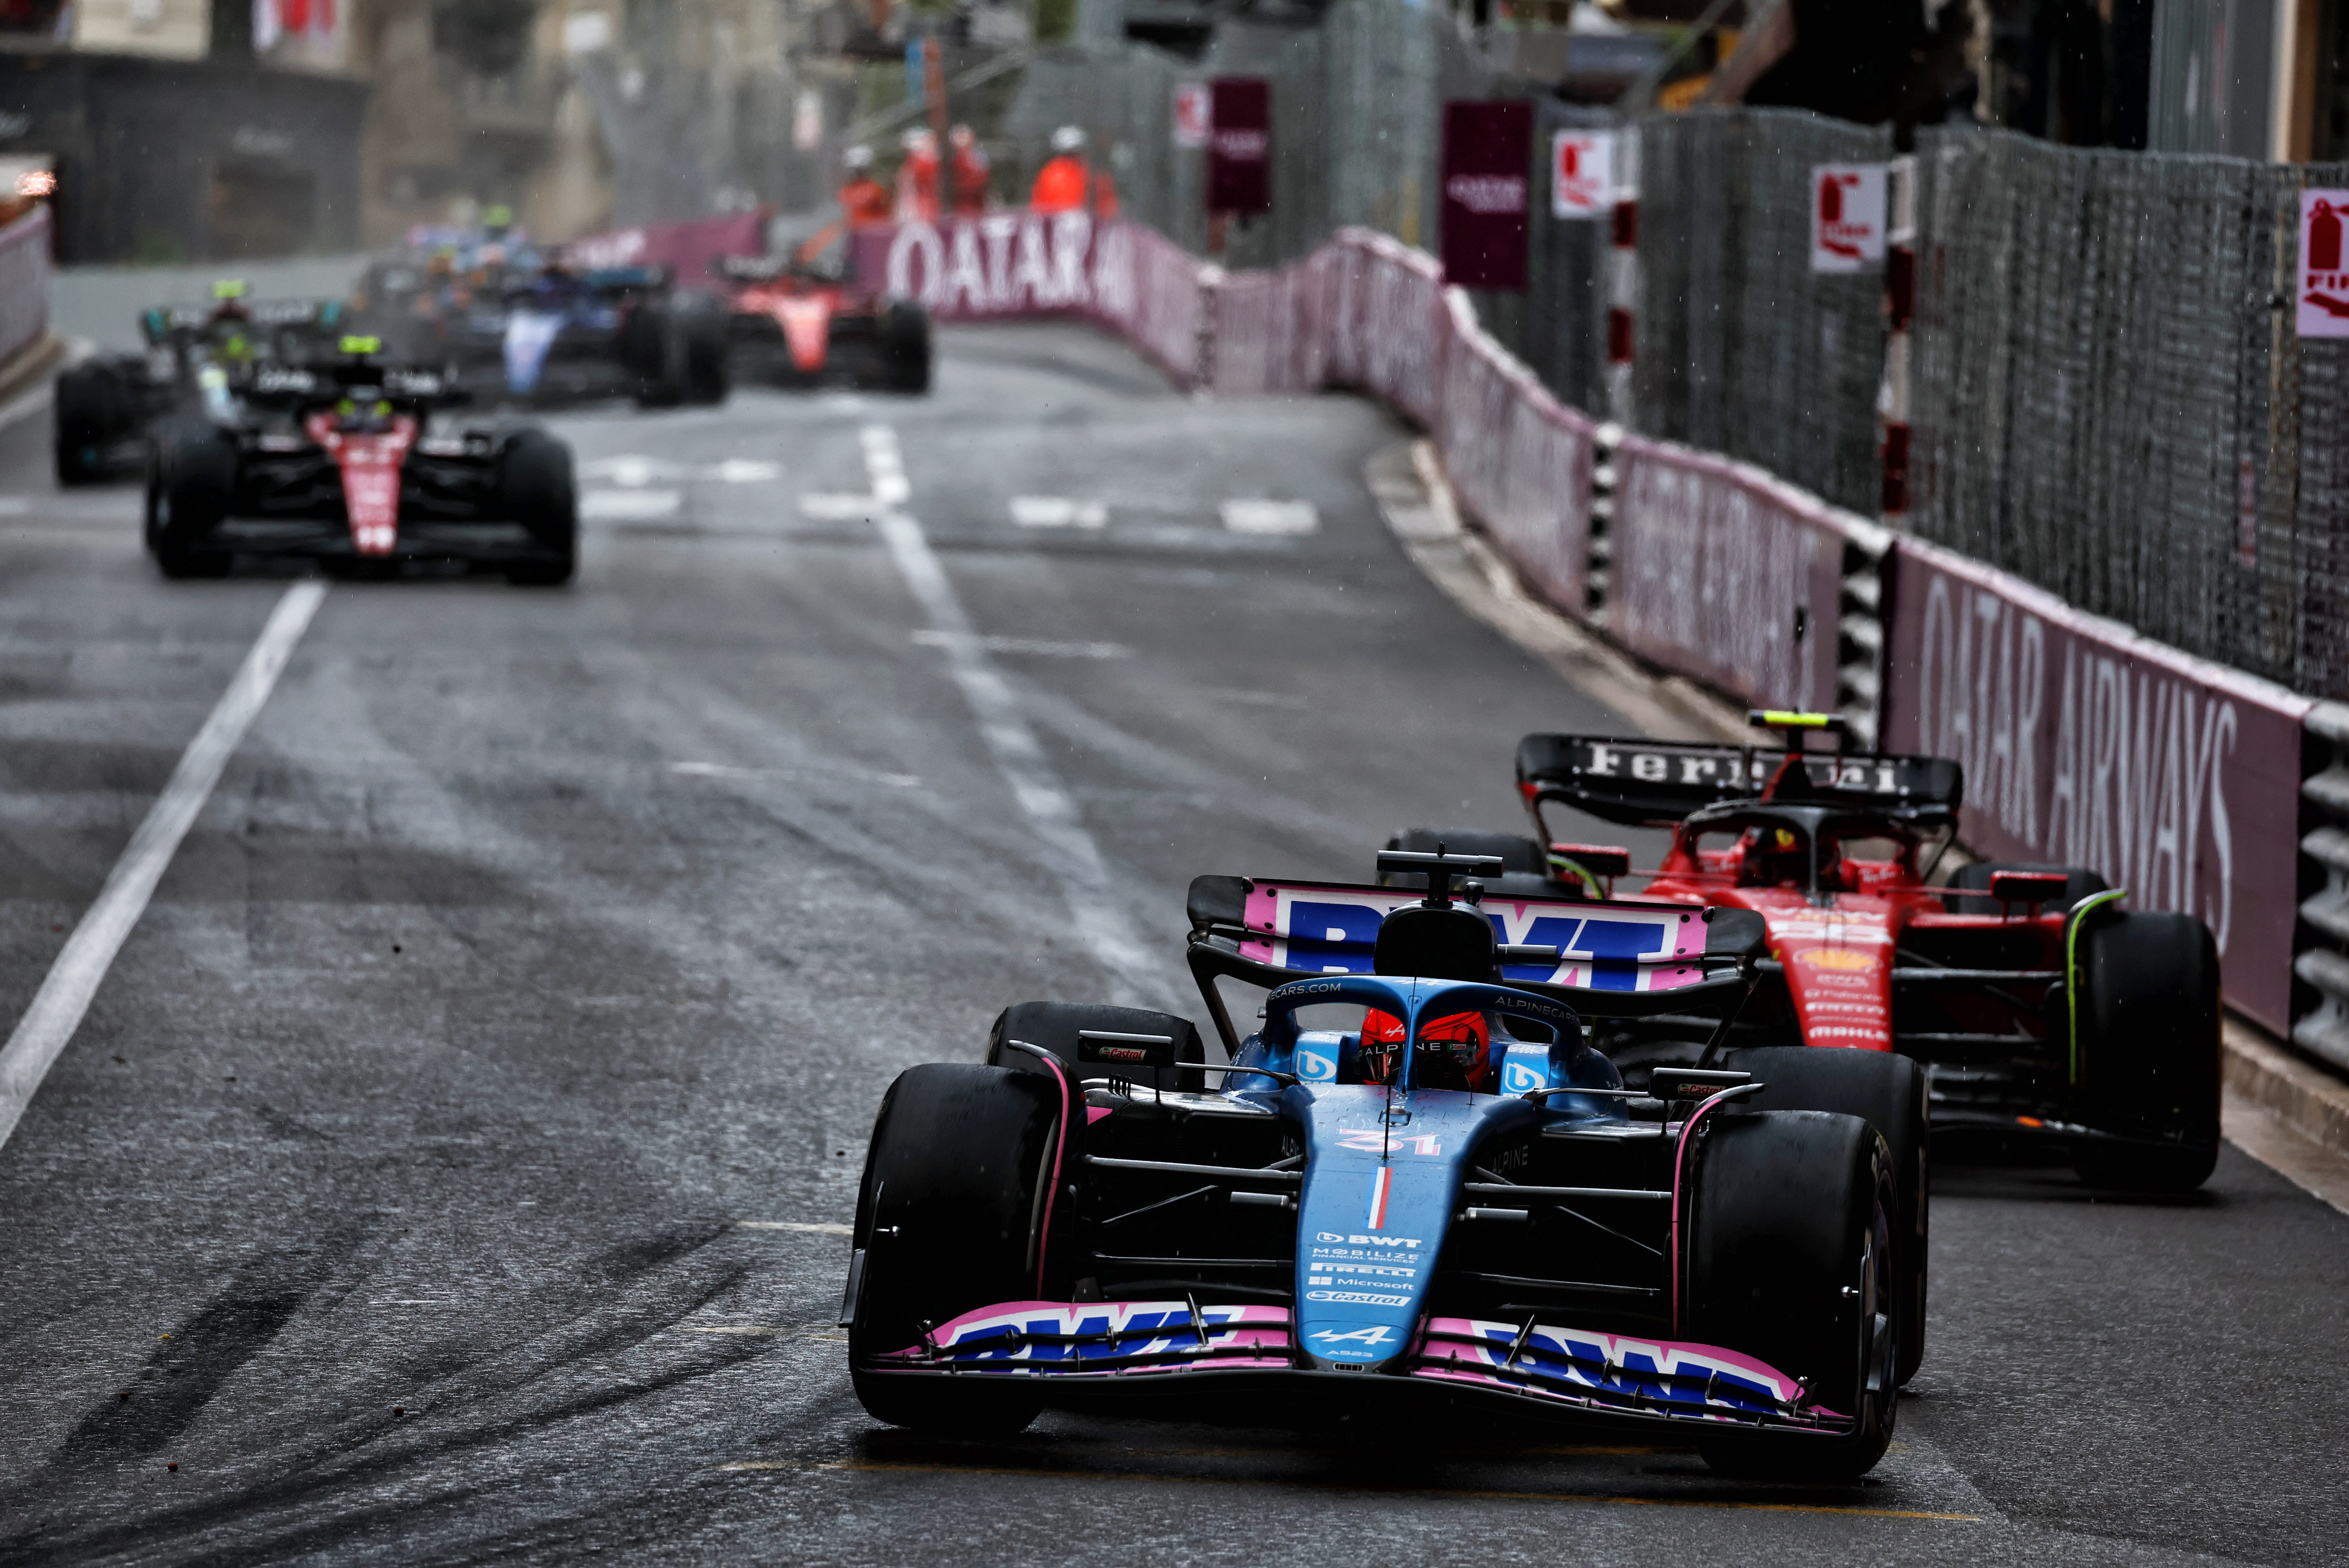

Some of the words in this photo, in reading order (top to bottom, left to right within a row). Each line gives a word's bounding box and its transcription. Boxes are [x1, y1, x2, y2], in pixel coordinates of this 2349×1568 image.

[1110, 1048, 1143, 1060] Castrol
[1334, 1129, 1441, 1156] 31
[1492, 1144, 1529, 1174] ALPINE
[1348, 1235, 1422, 1248] BWT
[1310, 1262, 1416, 1277] PIRELLI
[1337, 1279, 1414, 1290] Microsoft
[1331, 1293, 1402, 1304] Castrol
